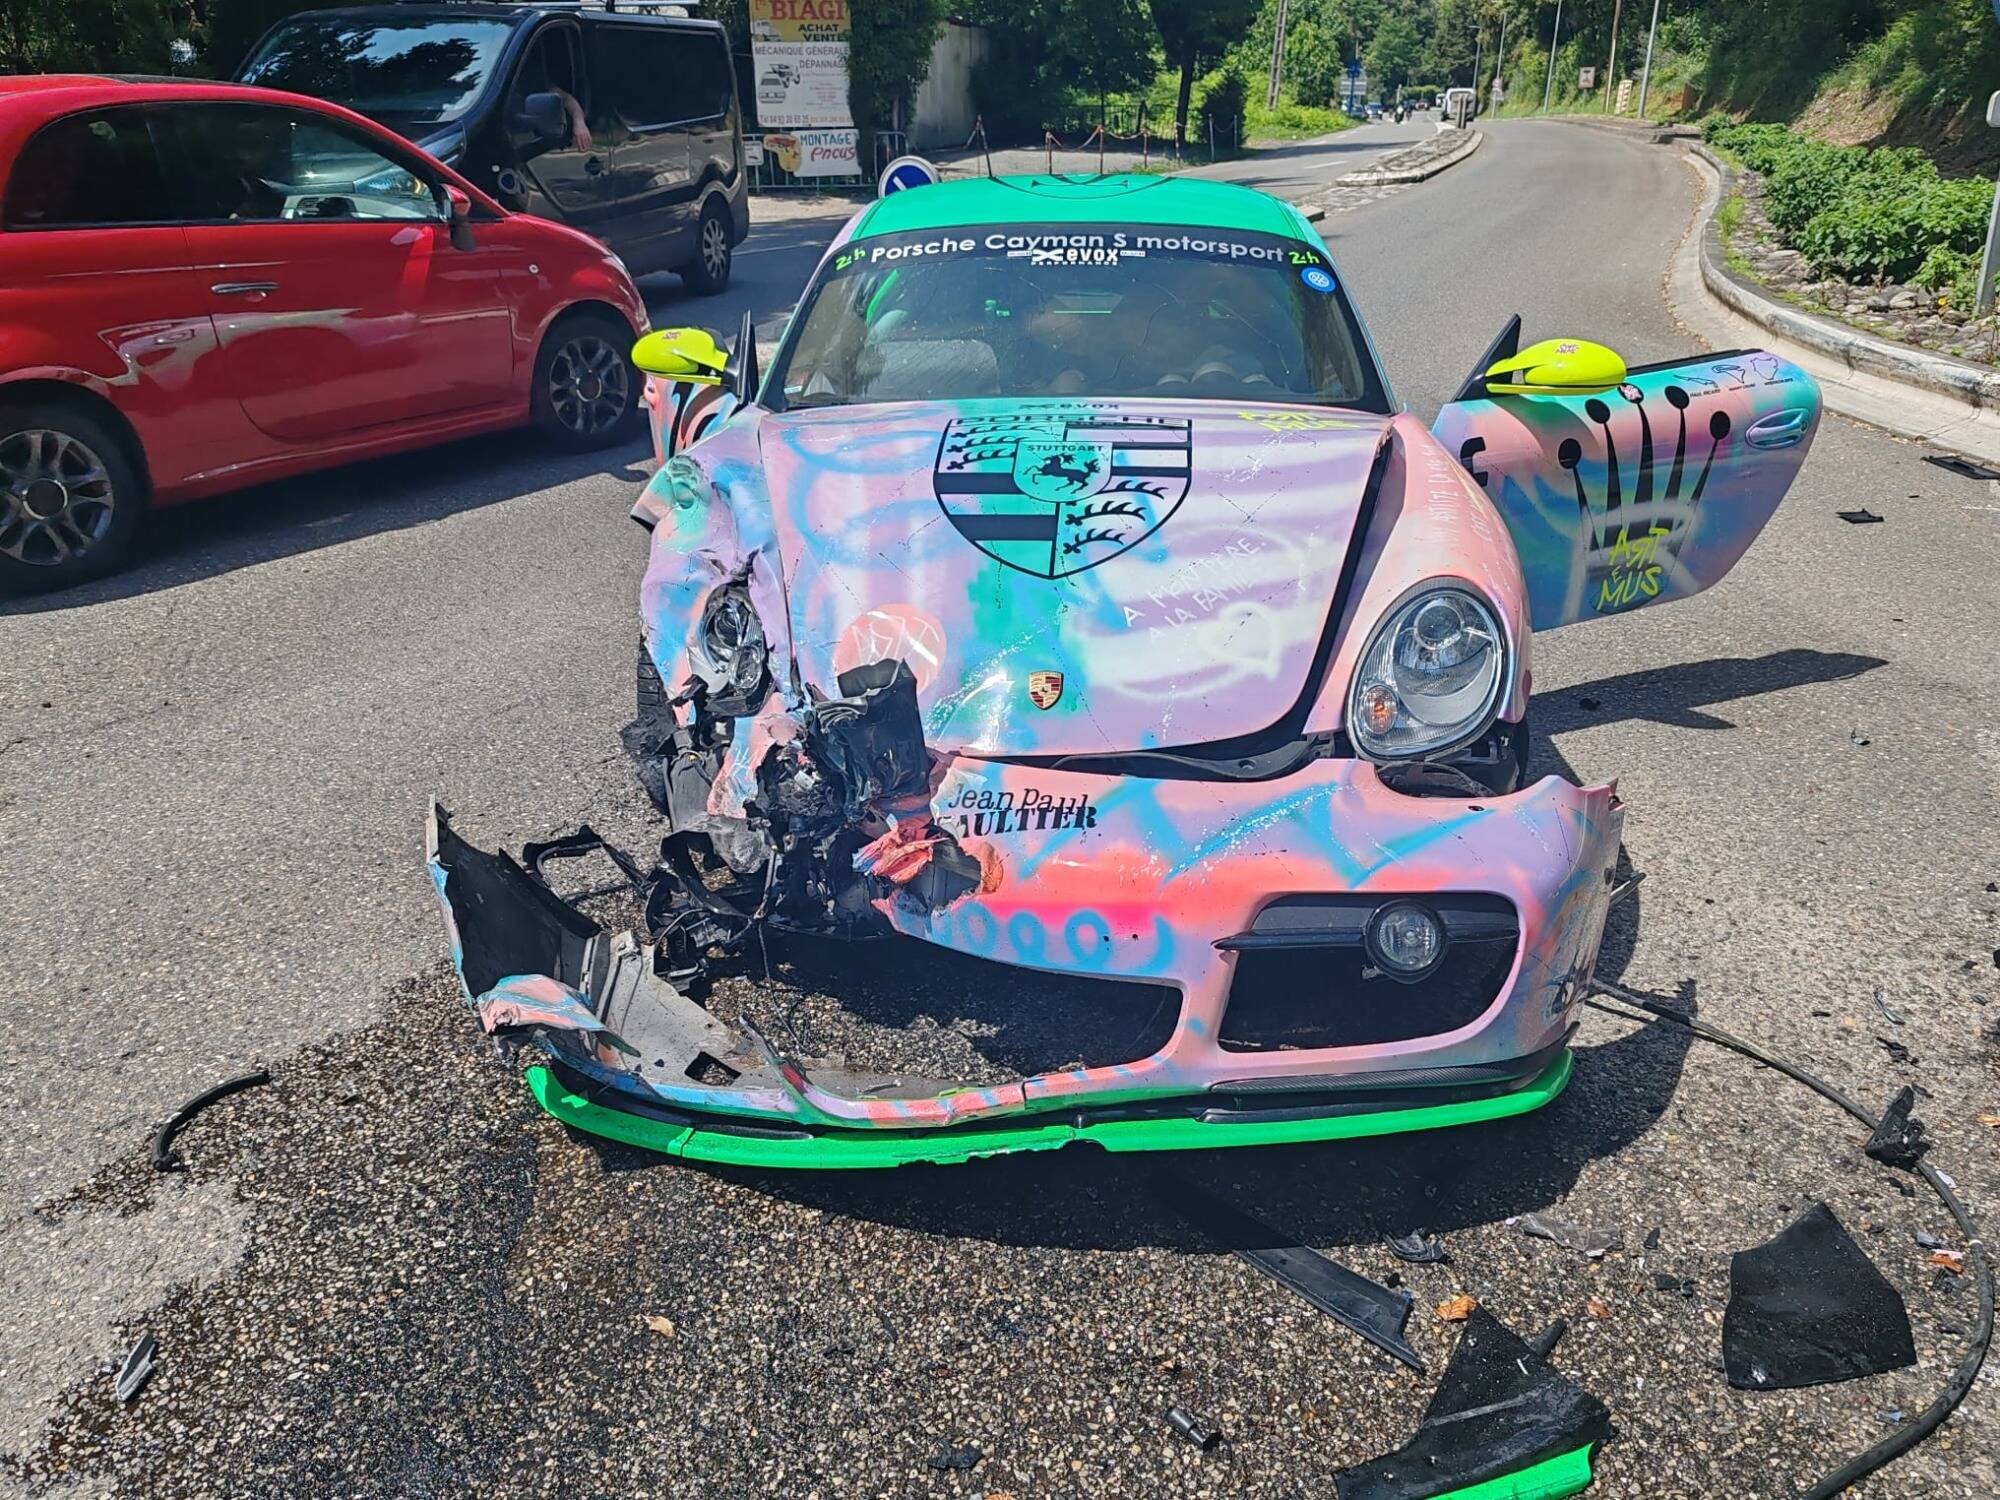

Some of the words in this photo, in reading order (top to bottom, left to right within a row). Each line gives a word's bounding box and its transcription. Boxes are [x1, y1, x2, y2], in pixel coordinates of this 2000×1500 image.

[769, 0, 845, 20] BIAGI
[798, 23, 839, 32] ACHAT
[800, 133, 851, 146] MONTAGE
[871, 237, 976, 263] Porsche
[985, 233, 1104, 250] Cayman
[1113, 233, 1127, 248] S
[1137, 236, 1284, 262] motorsport
[1027, 444, 1104, 452] STUTTGART
[1123, 605, 1146, 628] A
[948, 782, 1014, 811] Jean
[1019, 788, 1089, 813] Paul
